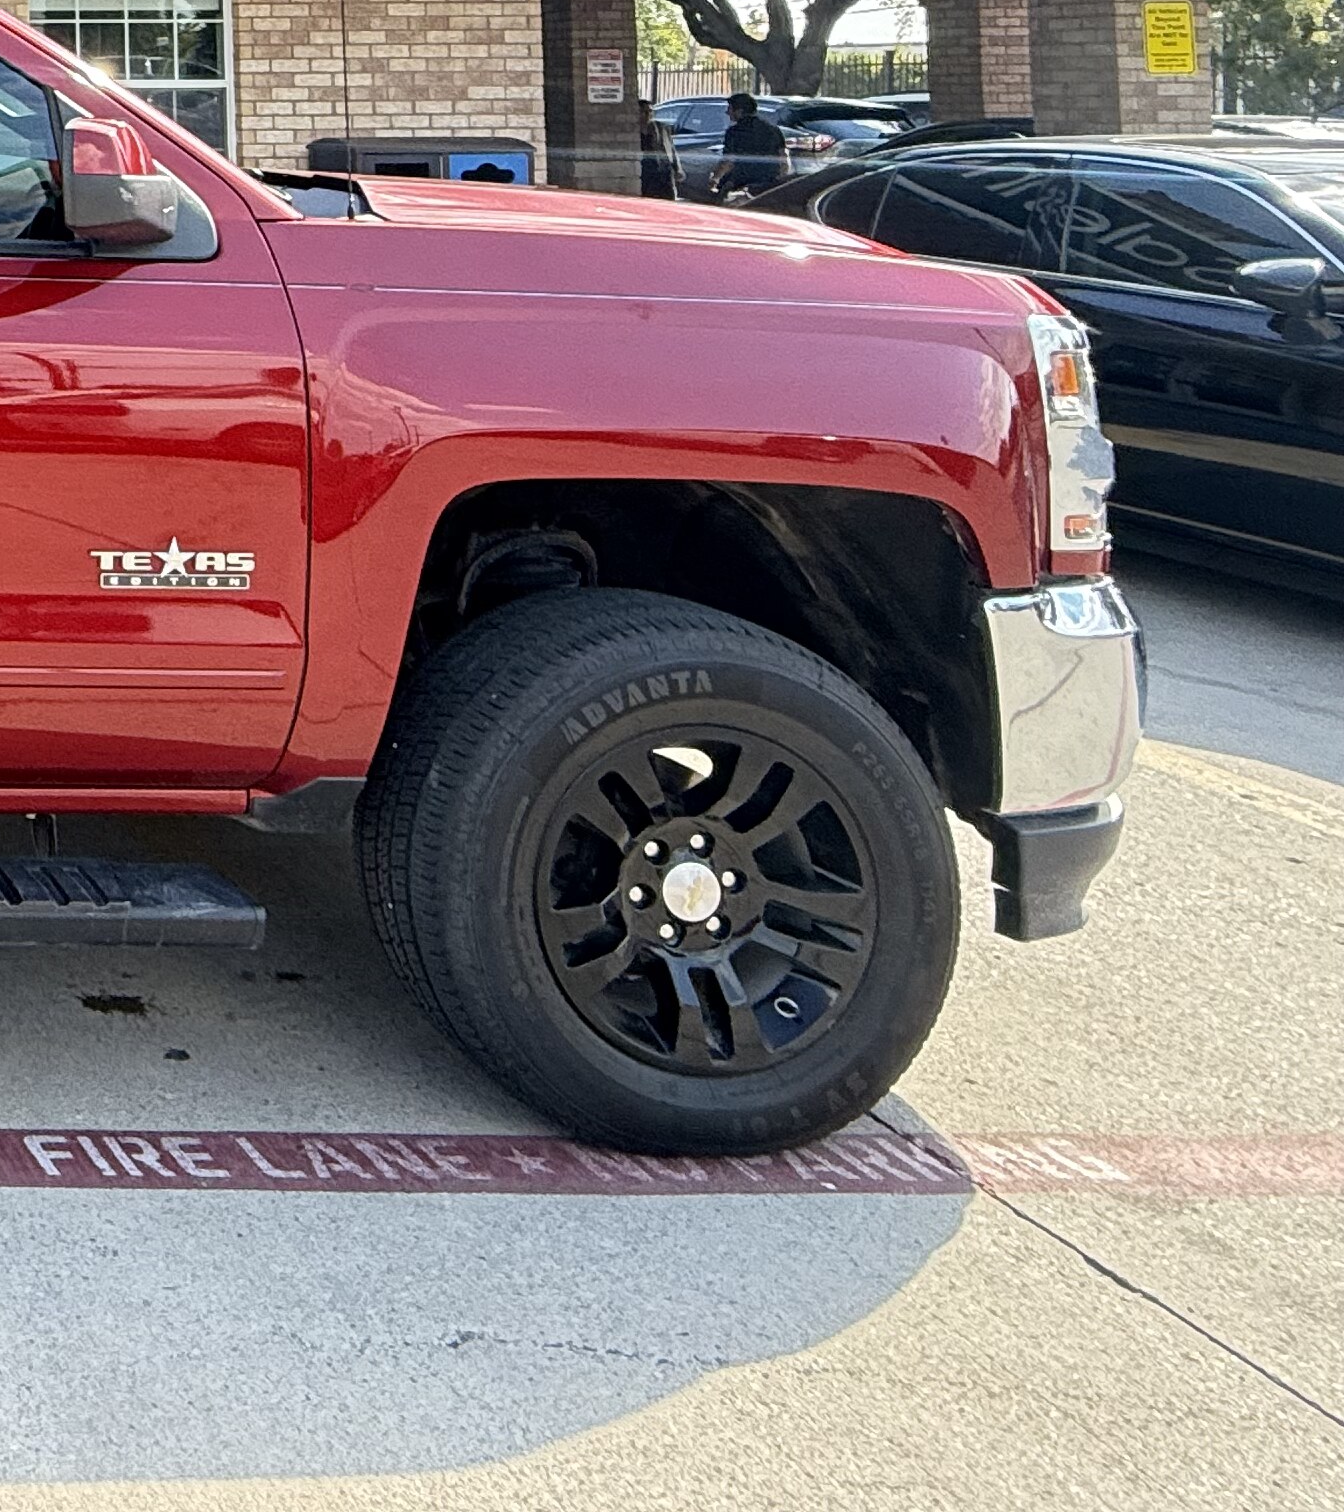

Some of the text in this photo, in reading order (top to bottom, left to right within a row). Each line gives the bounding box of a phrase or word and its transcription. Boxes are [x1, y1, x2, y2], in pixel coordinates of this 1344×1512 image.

[109, 575, 241, 587] EDITION
[561, 669, 712, 746] ADVANTA
[23, 1134, 231, 1179] FIRE
[235, 1136, 493, 1180] LANE
